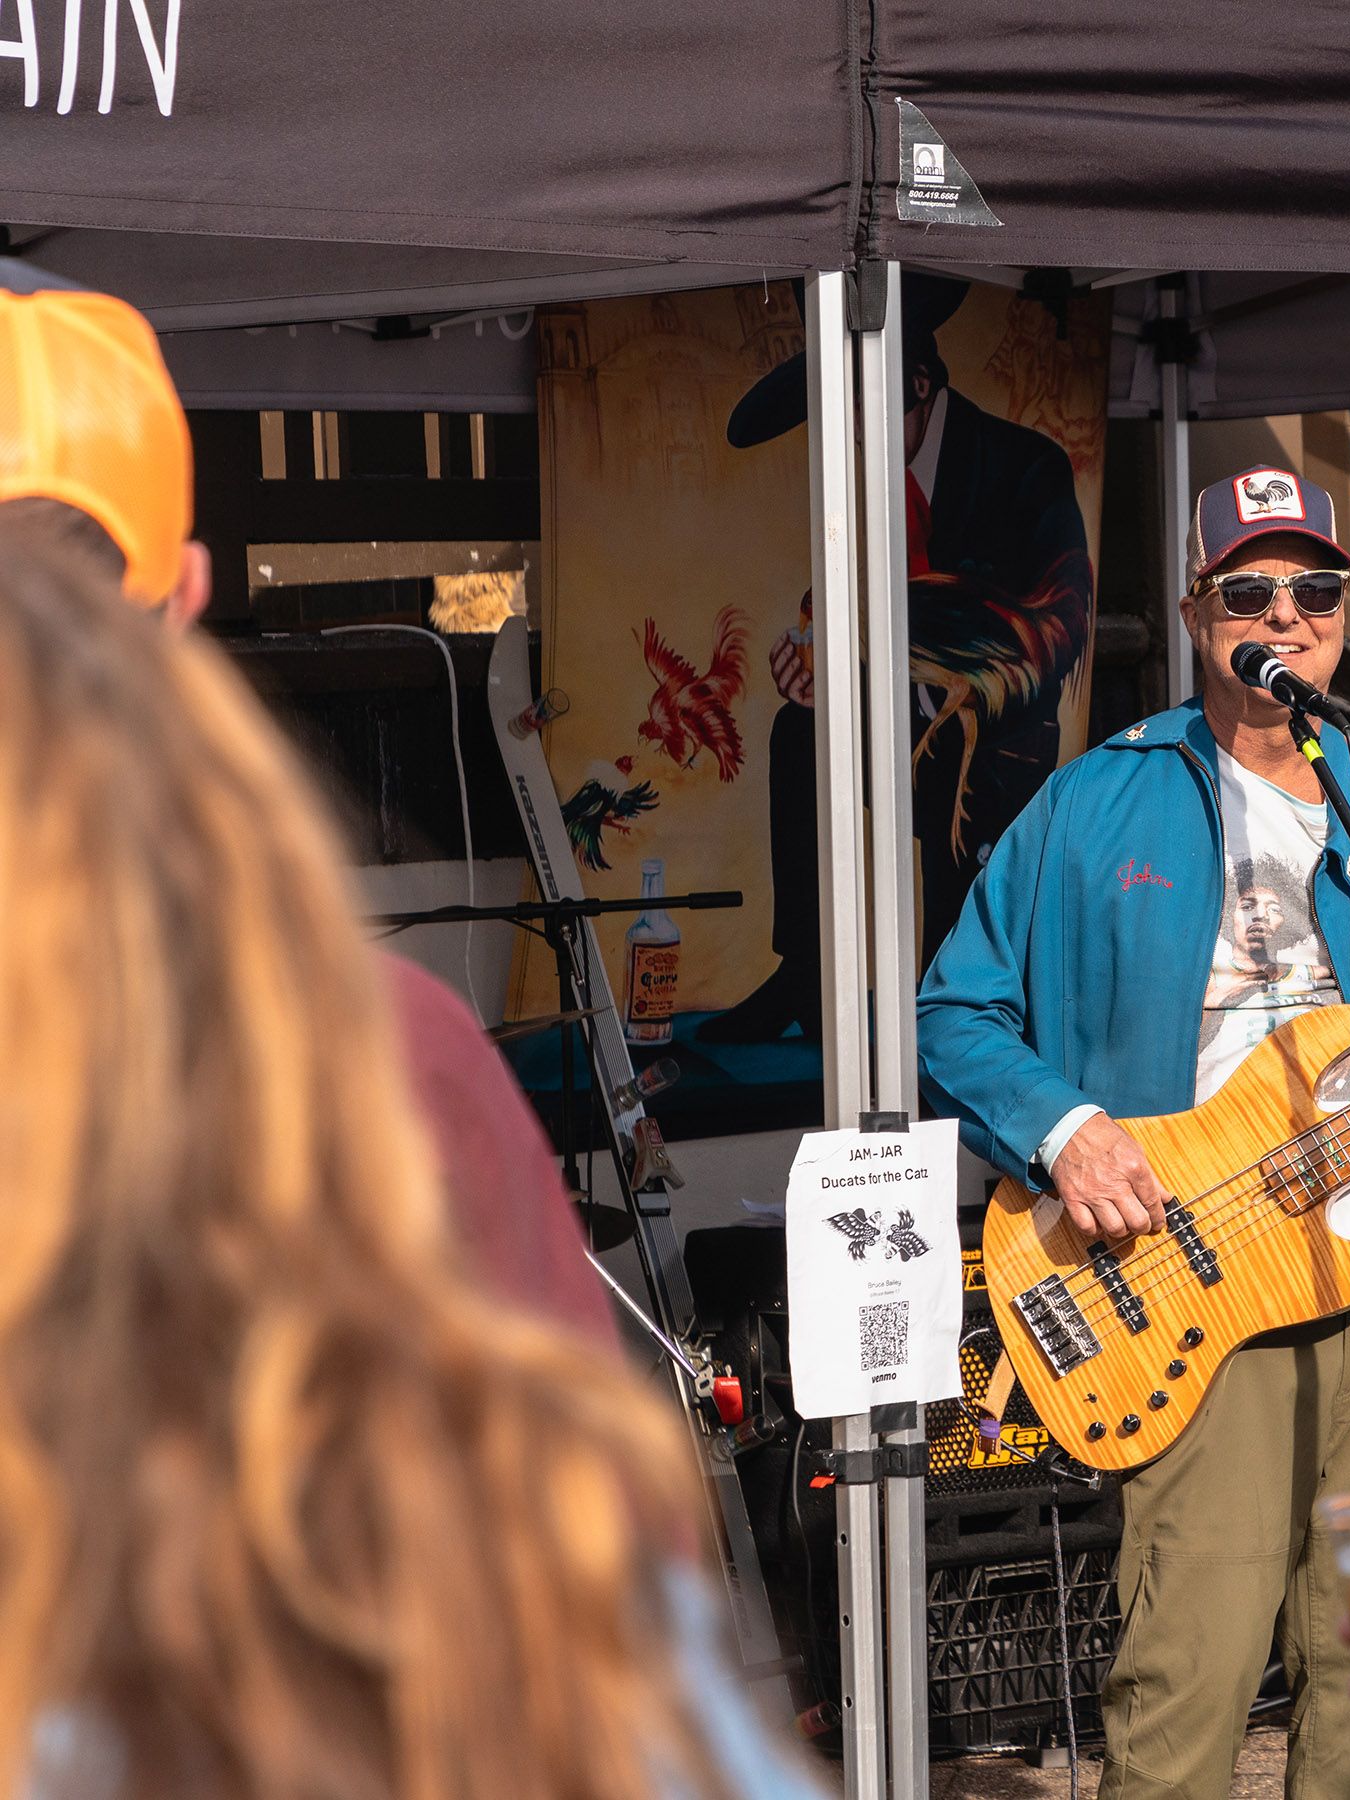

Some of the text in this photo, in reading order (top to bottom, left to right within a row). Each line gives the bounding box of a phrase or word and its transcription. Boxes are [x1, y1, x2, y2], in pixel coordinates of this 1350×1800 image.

[821, 1168, 928, 1189] Ducats for the Catz
[871, 1372, 897, 1384] venmo
